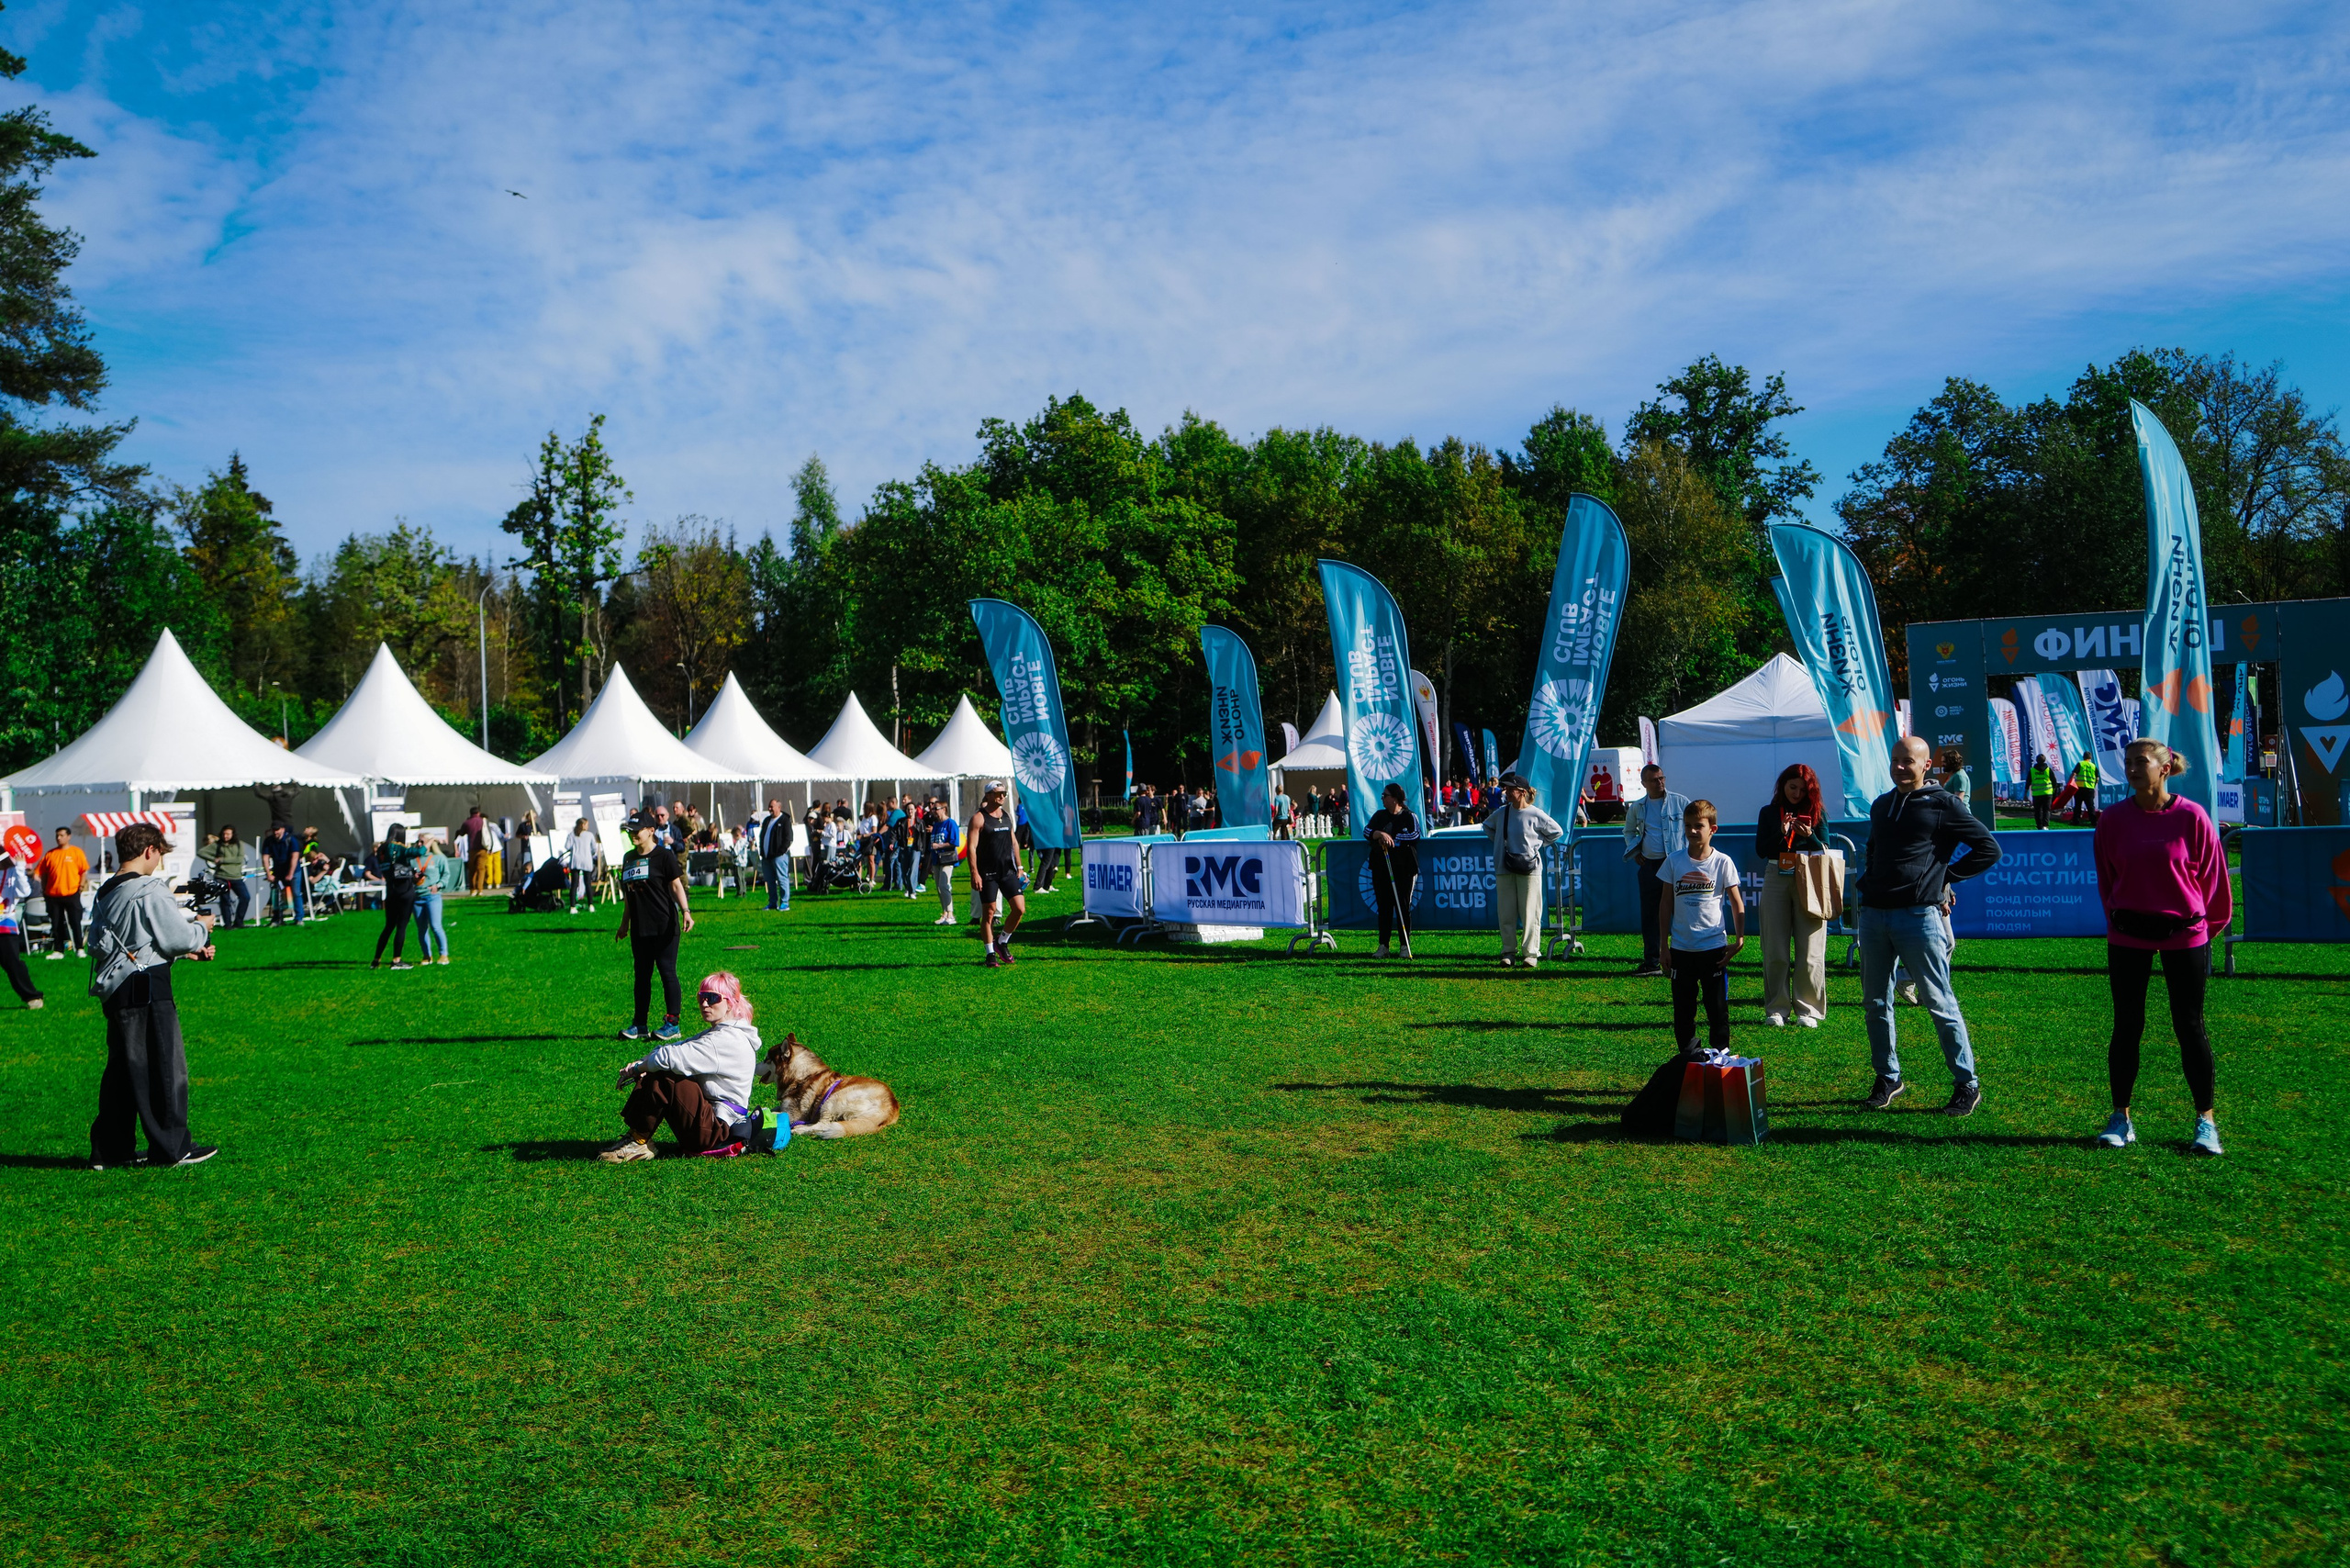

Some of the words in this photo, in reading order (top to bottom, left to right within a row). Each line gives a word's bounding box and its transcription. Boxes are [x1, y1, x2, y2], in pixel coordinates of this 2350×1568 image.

[2033, 620, 2224, 660] ФИН
[2221, 791, 2239, 808] MAER
[1432, 856, 1495, 872] NOBLE
[1993, 852, 2056, 868] ОЛГО
[2065, 852, 2078, 866] И
[628, 868, 641, 877] 104
[1097, 864, 1133, 892] MAER
[1185, 856, 1263, 898] RMG
[1984, 871, 2098, 886] СЧАСТЛИВ
[1434, 874, 1497, 890] IMPAC
[1675, 879, 1716, 893] Trussardi
[1187, 899, 1216, 909] РУССКАЯ
[1216, 900, 1266, 911] МЕДИАГРУППА
[1435, 892, 1487, 909] CLUB
[1985, 895, 2021, 905] ФОНД
[2024, 895, 2082, 904] ПОМОЩИ
[1986, 909, 2052, 918] ПОЖИЛЫМ
[1986, 923, 2031, 932] ЛЮДЯМ
